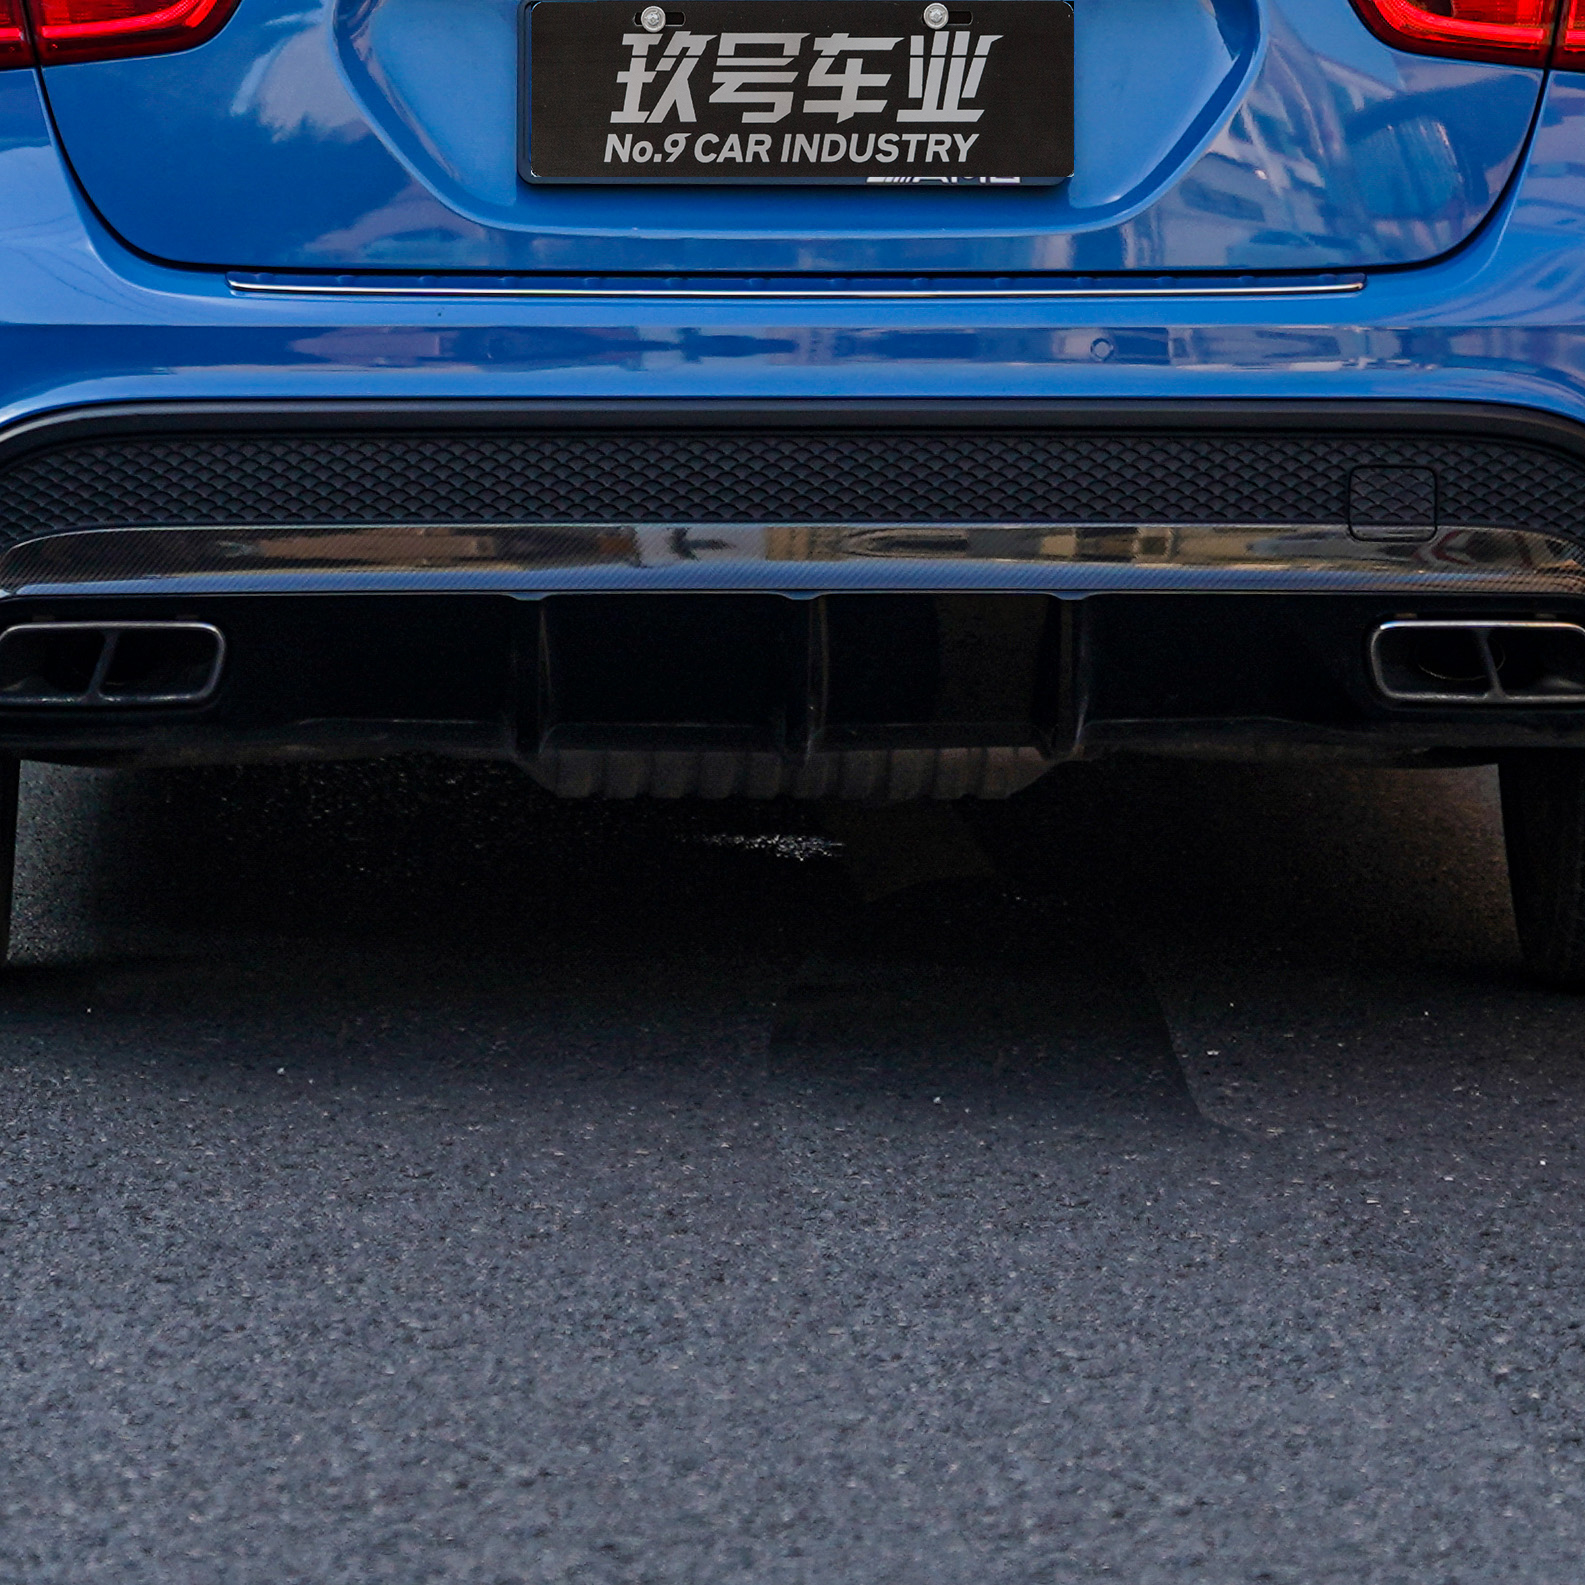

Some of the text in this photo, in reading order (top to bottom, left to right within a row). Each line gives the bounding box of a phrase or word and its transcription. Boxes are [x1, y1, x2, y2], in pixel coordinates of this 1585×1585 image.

[610, 31, 1003, 124] 玖号车业
[604, 133, 980, 163] No.9 CAR INDUSTRY
